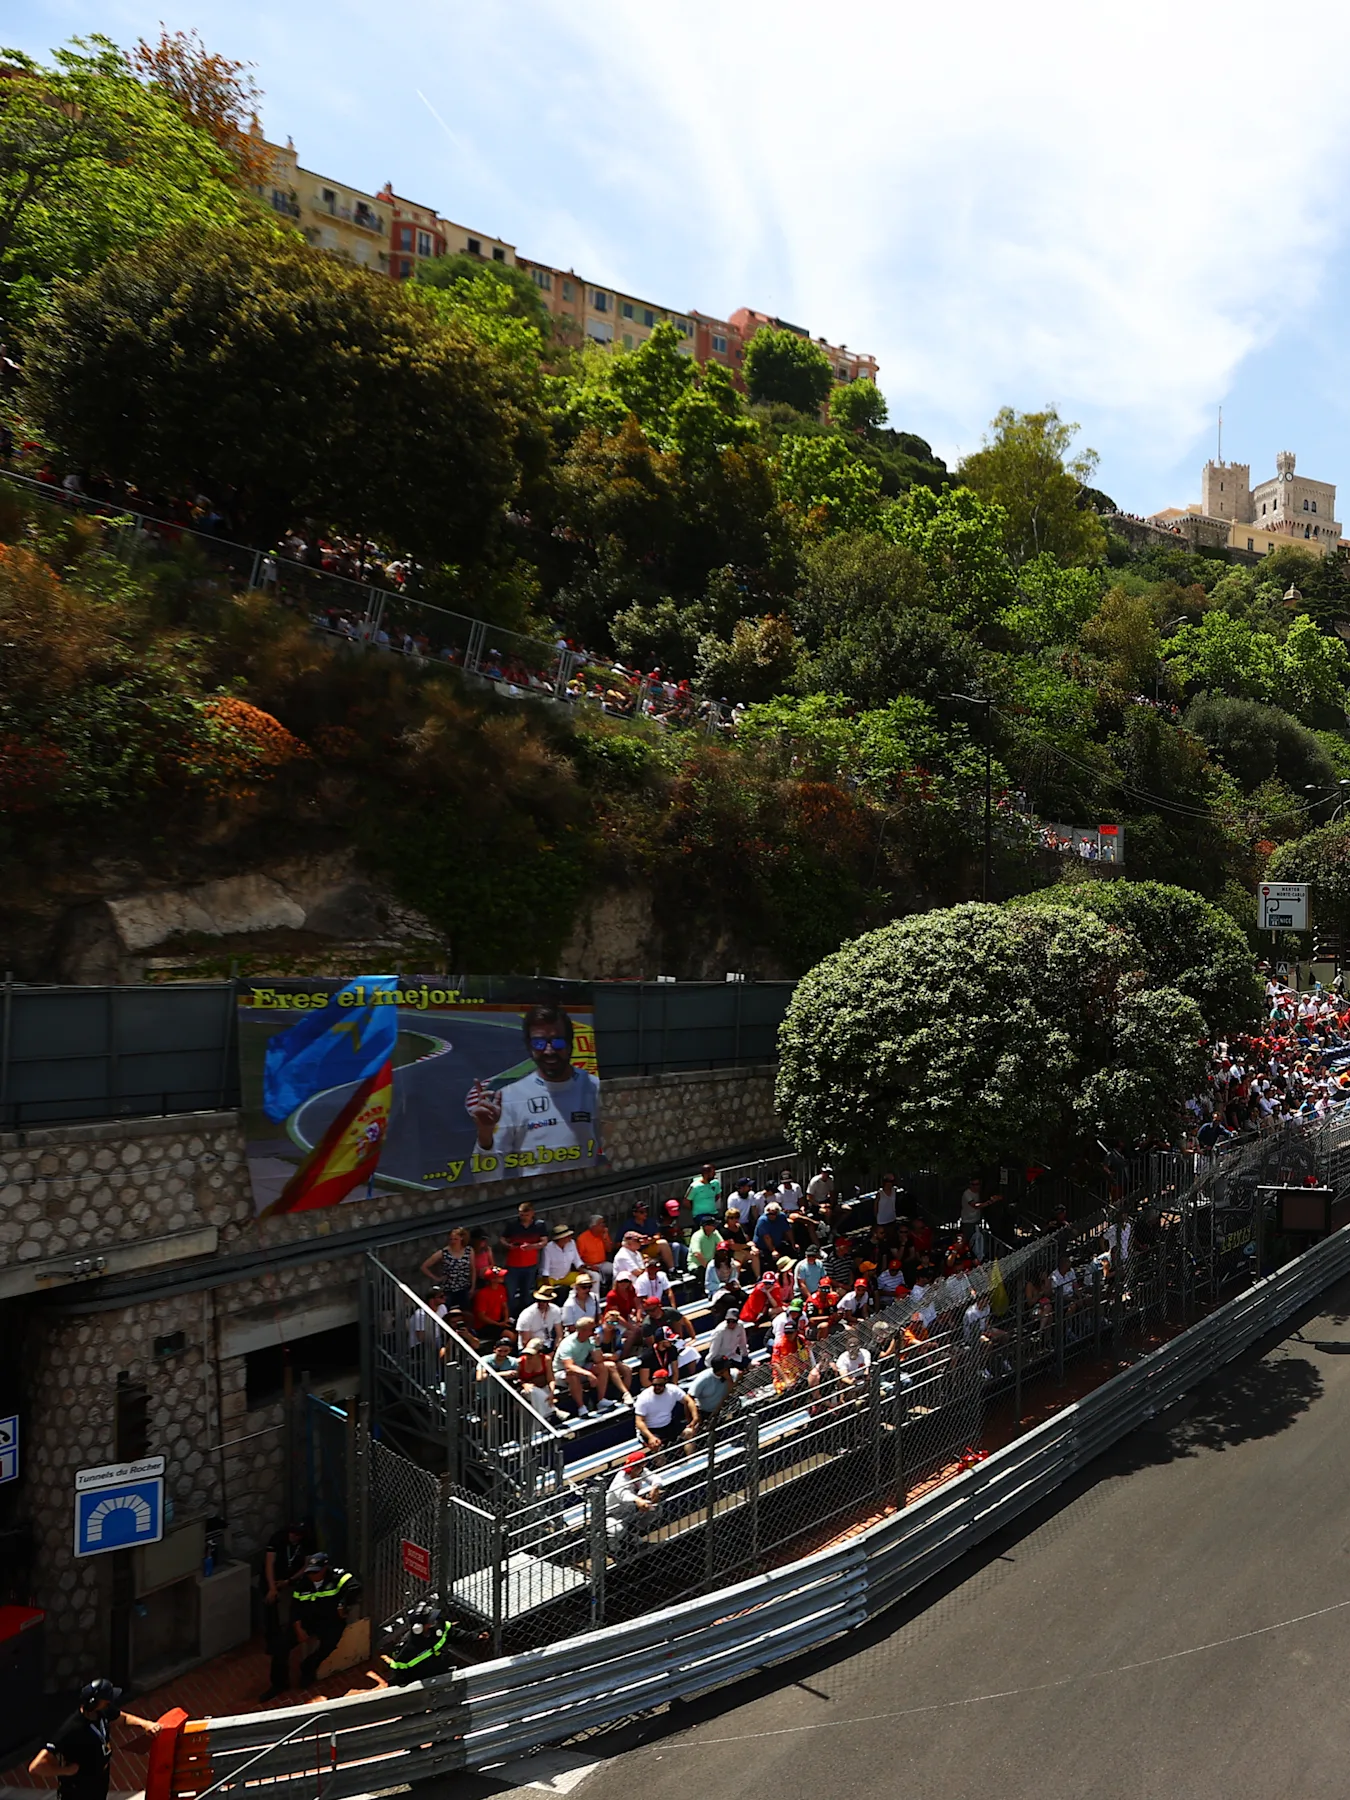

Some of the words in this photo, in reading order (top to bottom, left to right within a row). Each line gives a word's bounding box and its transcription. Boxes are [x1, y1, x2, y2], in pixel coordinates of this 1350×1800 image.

[251, 987, 329, 1009] Eres
[337, 986, 365, 1007] el
[471, 1154, 497, 1173] lo
[504, 1144, 581, 1168] sabes
[587, 1139, 594, 1157] !
[78, 1471, 114, 1484] Tunnels
[116, 1468, 128, 1476] du
[129, 1462, 162, 1475] Rocher
